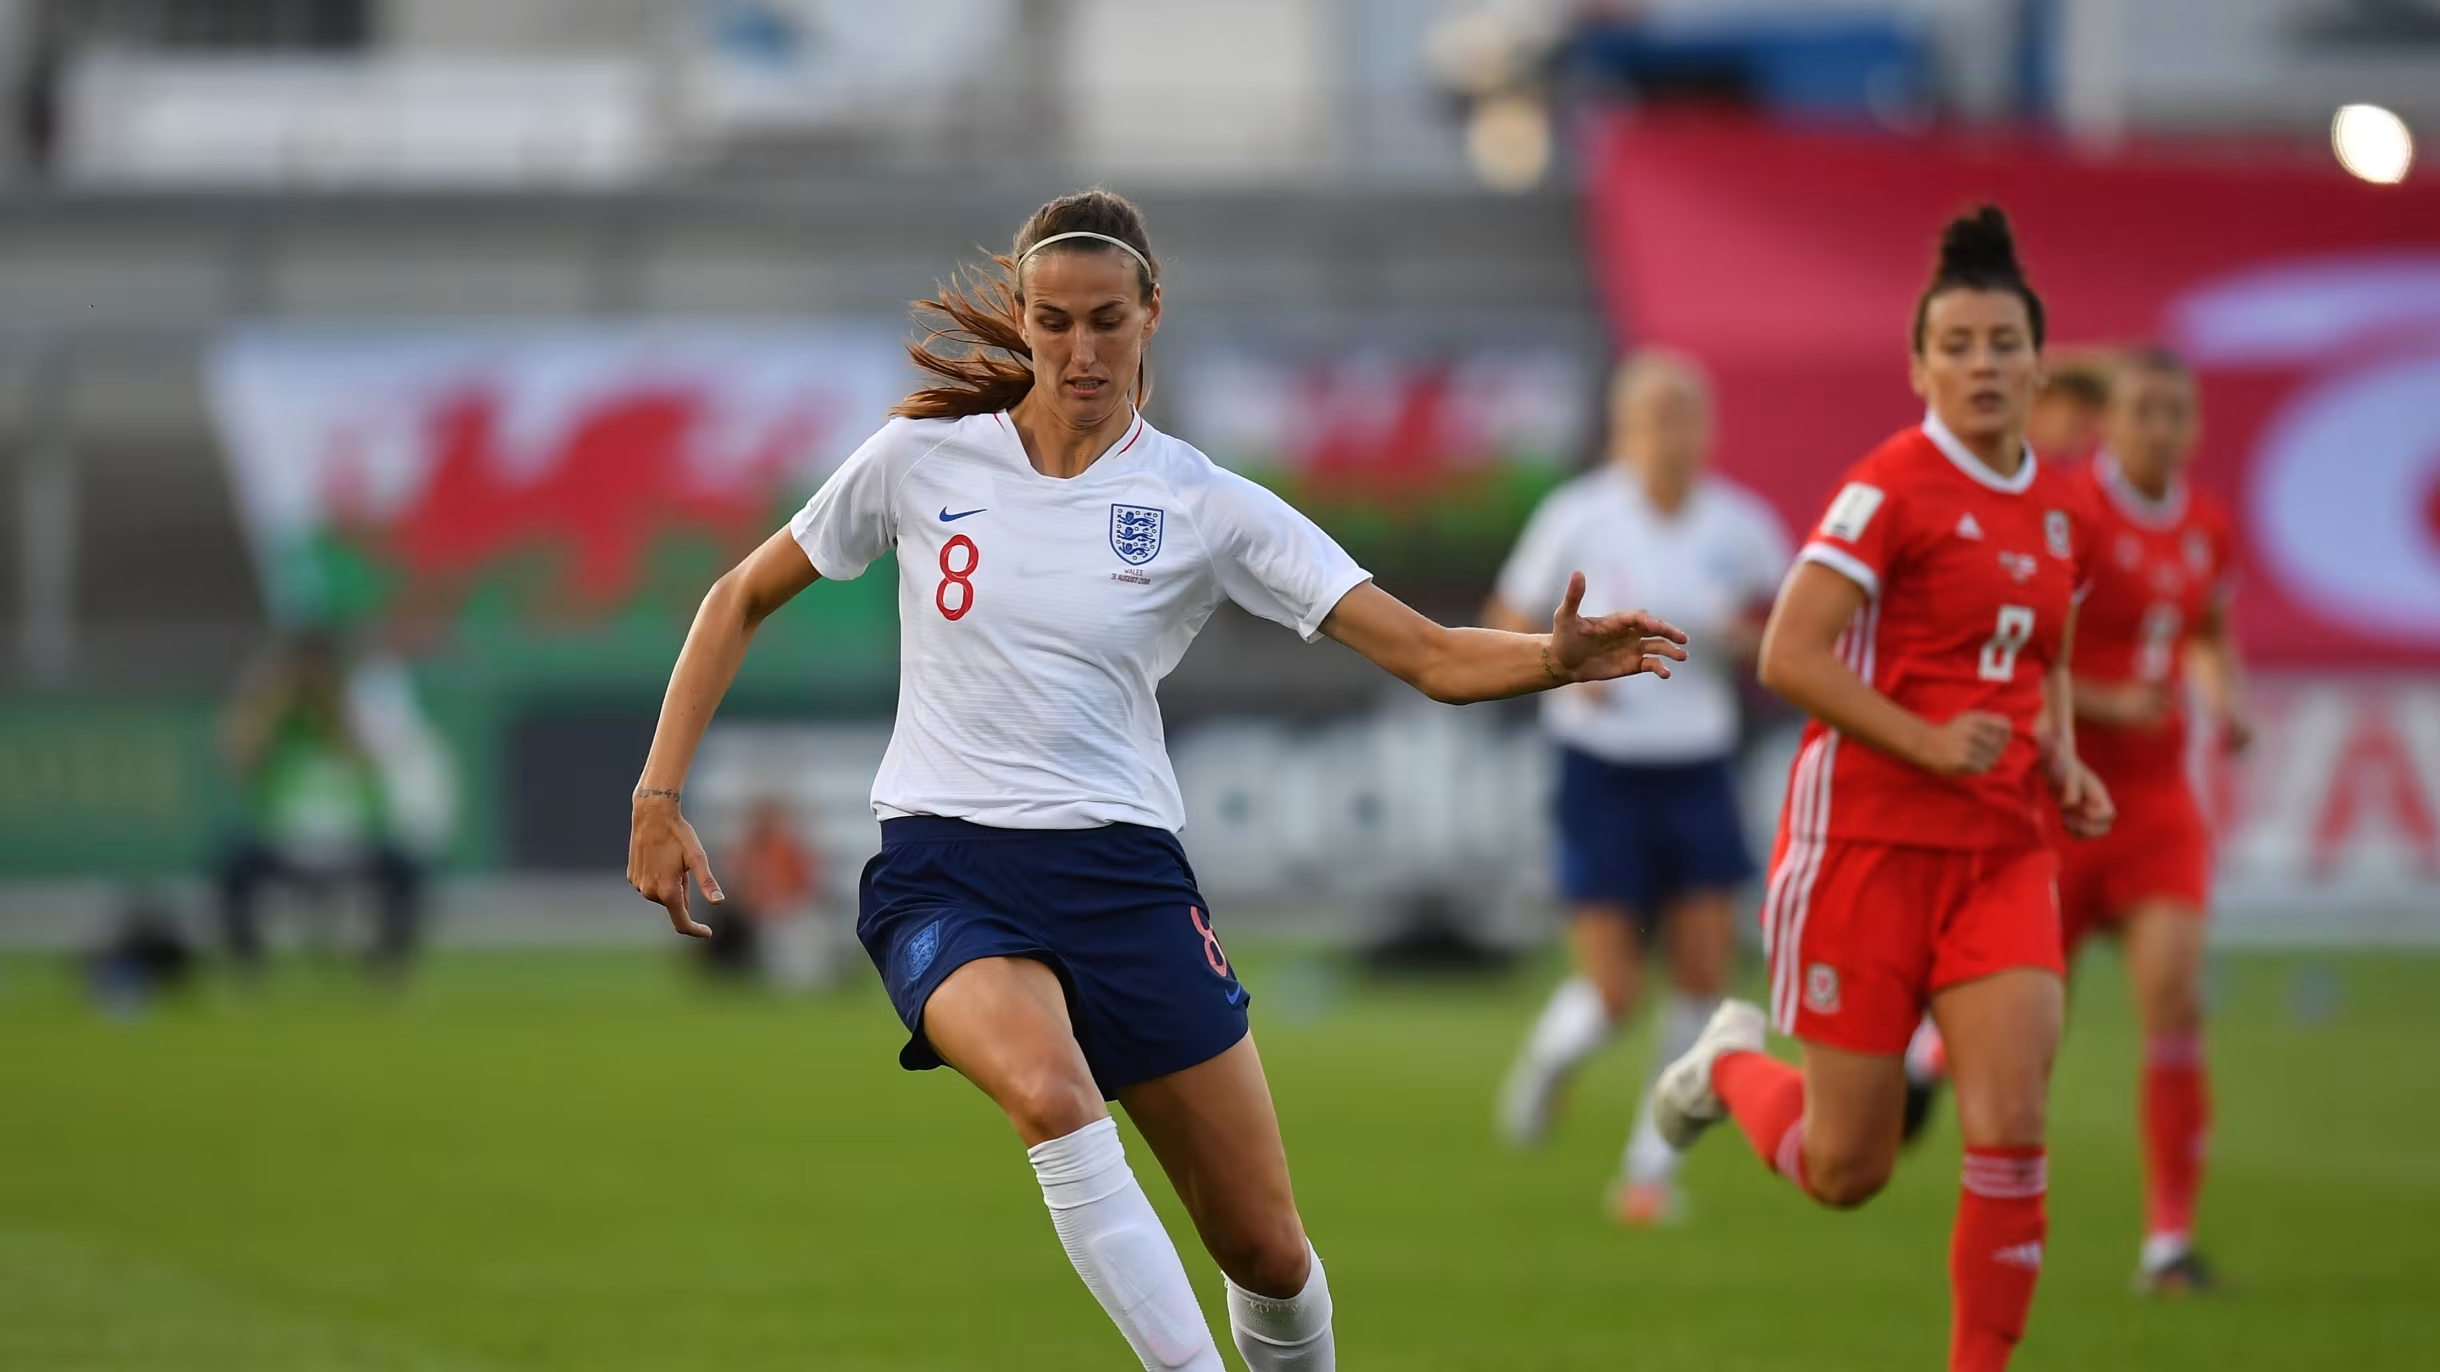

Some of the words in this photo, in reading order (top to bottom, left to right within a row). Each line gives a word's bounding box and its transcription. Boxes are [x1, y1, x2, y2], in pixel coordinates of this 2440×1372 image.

[936, 534, 979, 621] 8
[1117, 574, 1138, 583] AUGUST
[1123, 568, 1143, 576] WALES
[1978, 605, 2035, 681] 8
[1190, 905, 1227, 977] 8
